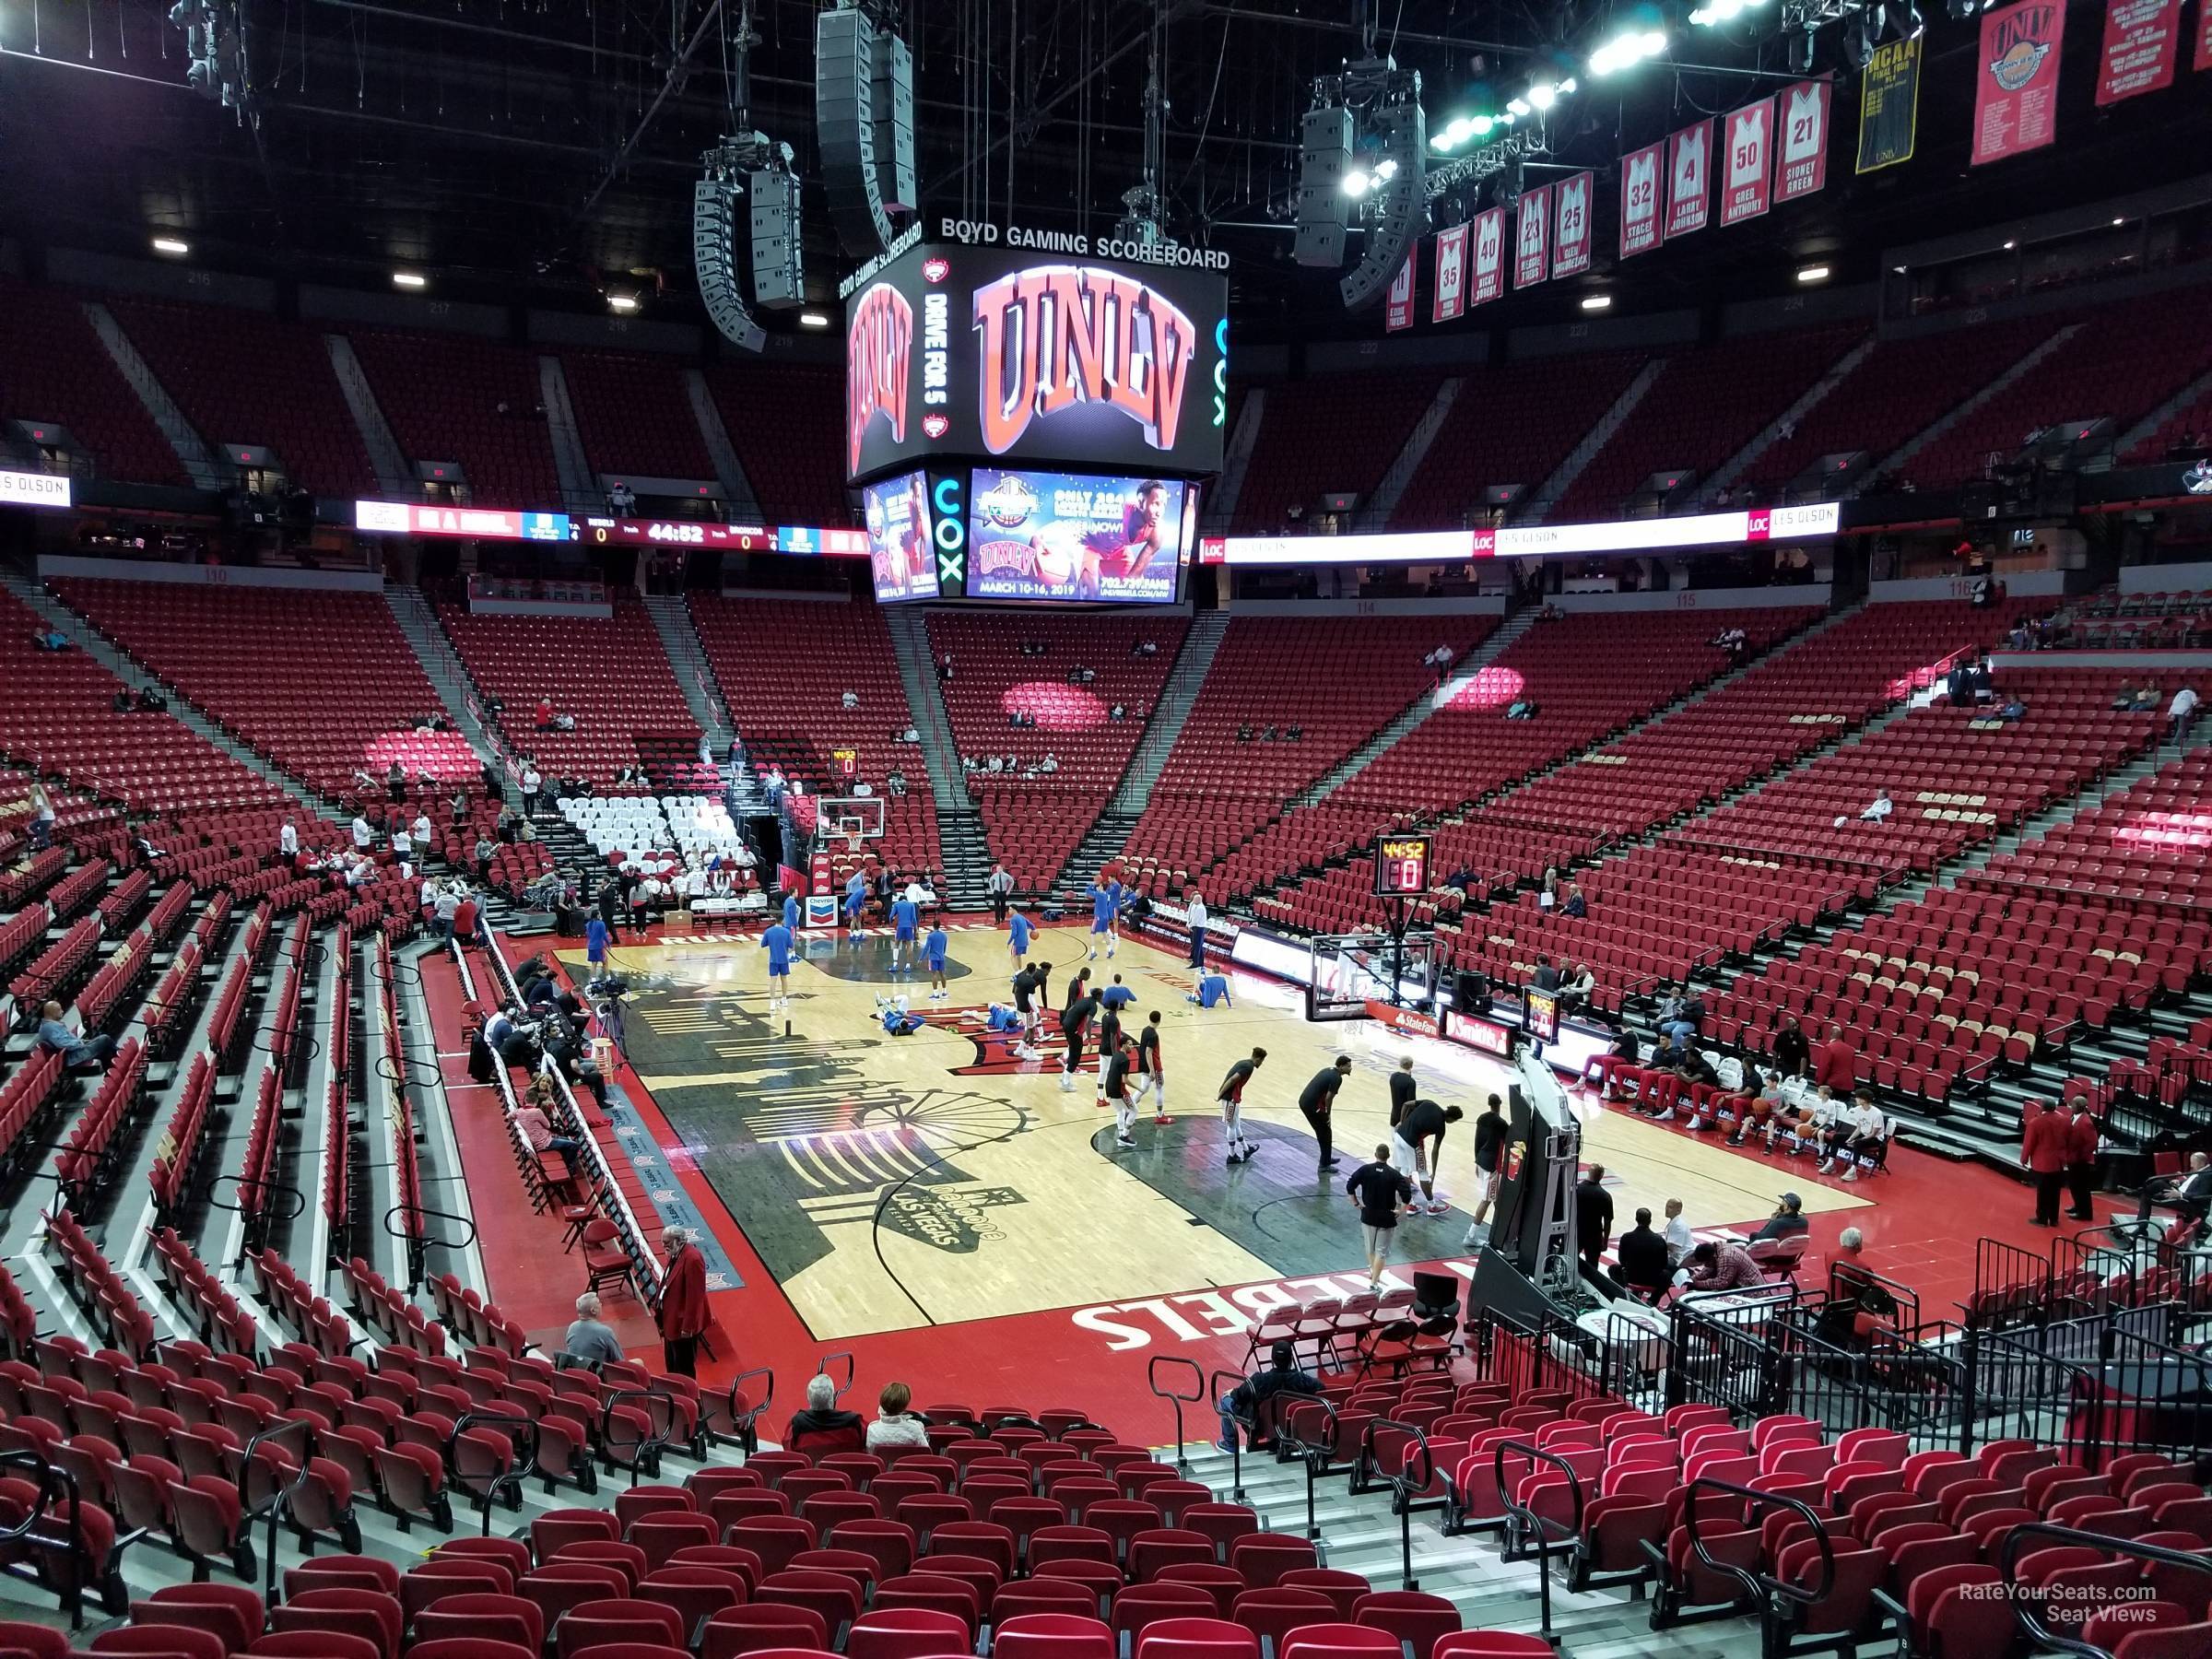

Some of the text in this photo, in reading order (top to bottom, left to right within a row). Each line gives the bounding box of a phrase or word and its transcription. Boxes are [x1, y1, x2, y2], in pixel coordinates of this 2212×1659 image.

[1991, 6, 2055, 59] UNLV
[1794, 115, 1813, 145] 21
[1735, 142, 1758, 170] 50
[1684, 159, 1695, 182] 4
[1786, 160, 1816, 182] SIDNEY
[1631, 182, 1651, 206] 32
[1787, 176, 1813, 194] GREEN
[1735, 188, 1755, 203] GREG
[1564, 206, 1581, 229] 25
[1677, 200, 1700, 217] LARRY
[1728, 199, 1762, 219] ANTHONY
[1524, 221, 1539, 241] 23
[1671, 211, 1704, 231] JOHNSON
[942, 218, 1230, 270] BOYD GAMING SCOREBOARD
[1480, 239, 1496, 259] 40
[840, 275, 854, 299] BOYD
[855, 256, 878, 287] GAMING
[1443, 266, 1457, 287] 35
[924, 294, 947, 404] DRIVE FOR 5
[972, 265, 1195, 454] UNLV
[849, 283, 913, 477] UNLV
[18, 477, 63, 493] OLSON
[1749, 518, 1769, 532] LOC
[1798, 509, 1833, 524] OLSON
[596, 528, 606, 542] 0
[648, 523, 704, 543] 44:52
[935, 479, 964, 582] COX
[741, 535, 751, 549] 0
[1205, 543, 1223, 557] LOC
[1475, 536, 1494, 550] LOC
[979, 541, 1038, 576] UNLV
[980, 582, 1076, 595] MARCH 10-16, 2019
[1357, 601, 1374, 615] 114
[1676, 593, 1696, 607] 115
[833, 750, 855, 759] 44:52
[844, 759, 853, 772] 0
[1383, 842, 1424, 859] 44:52
[1402, 860, 1418, 888] 0
[891, 1192, 960, 1246] LAS VEGAS
